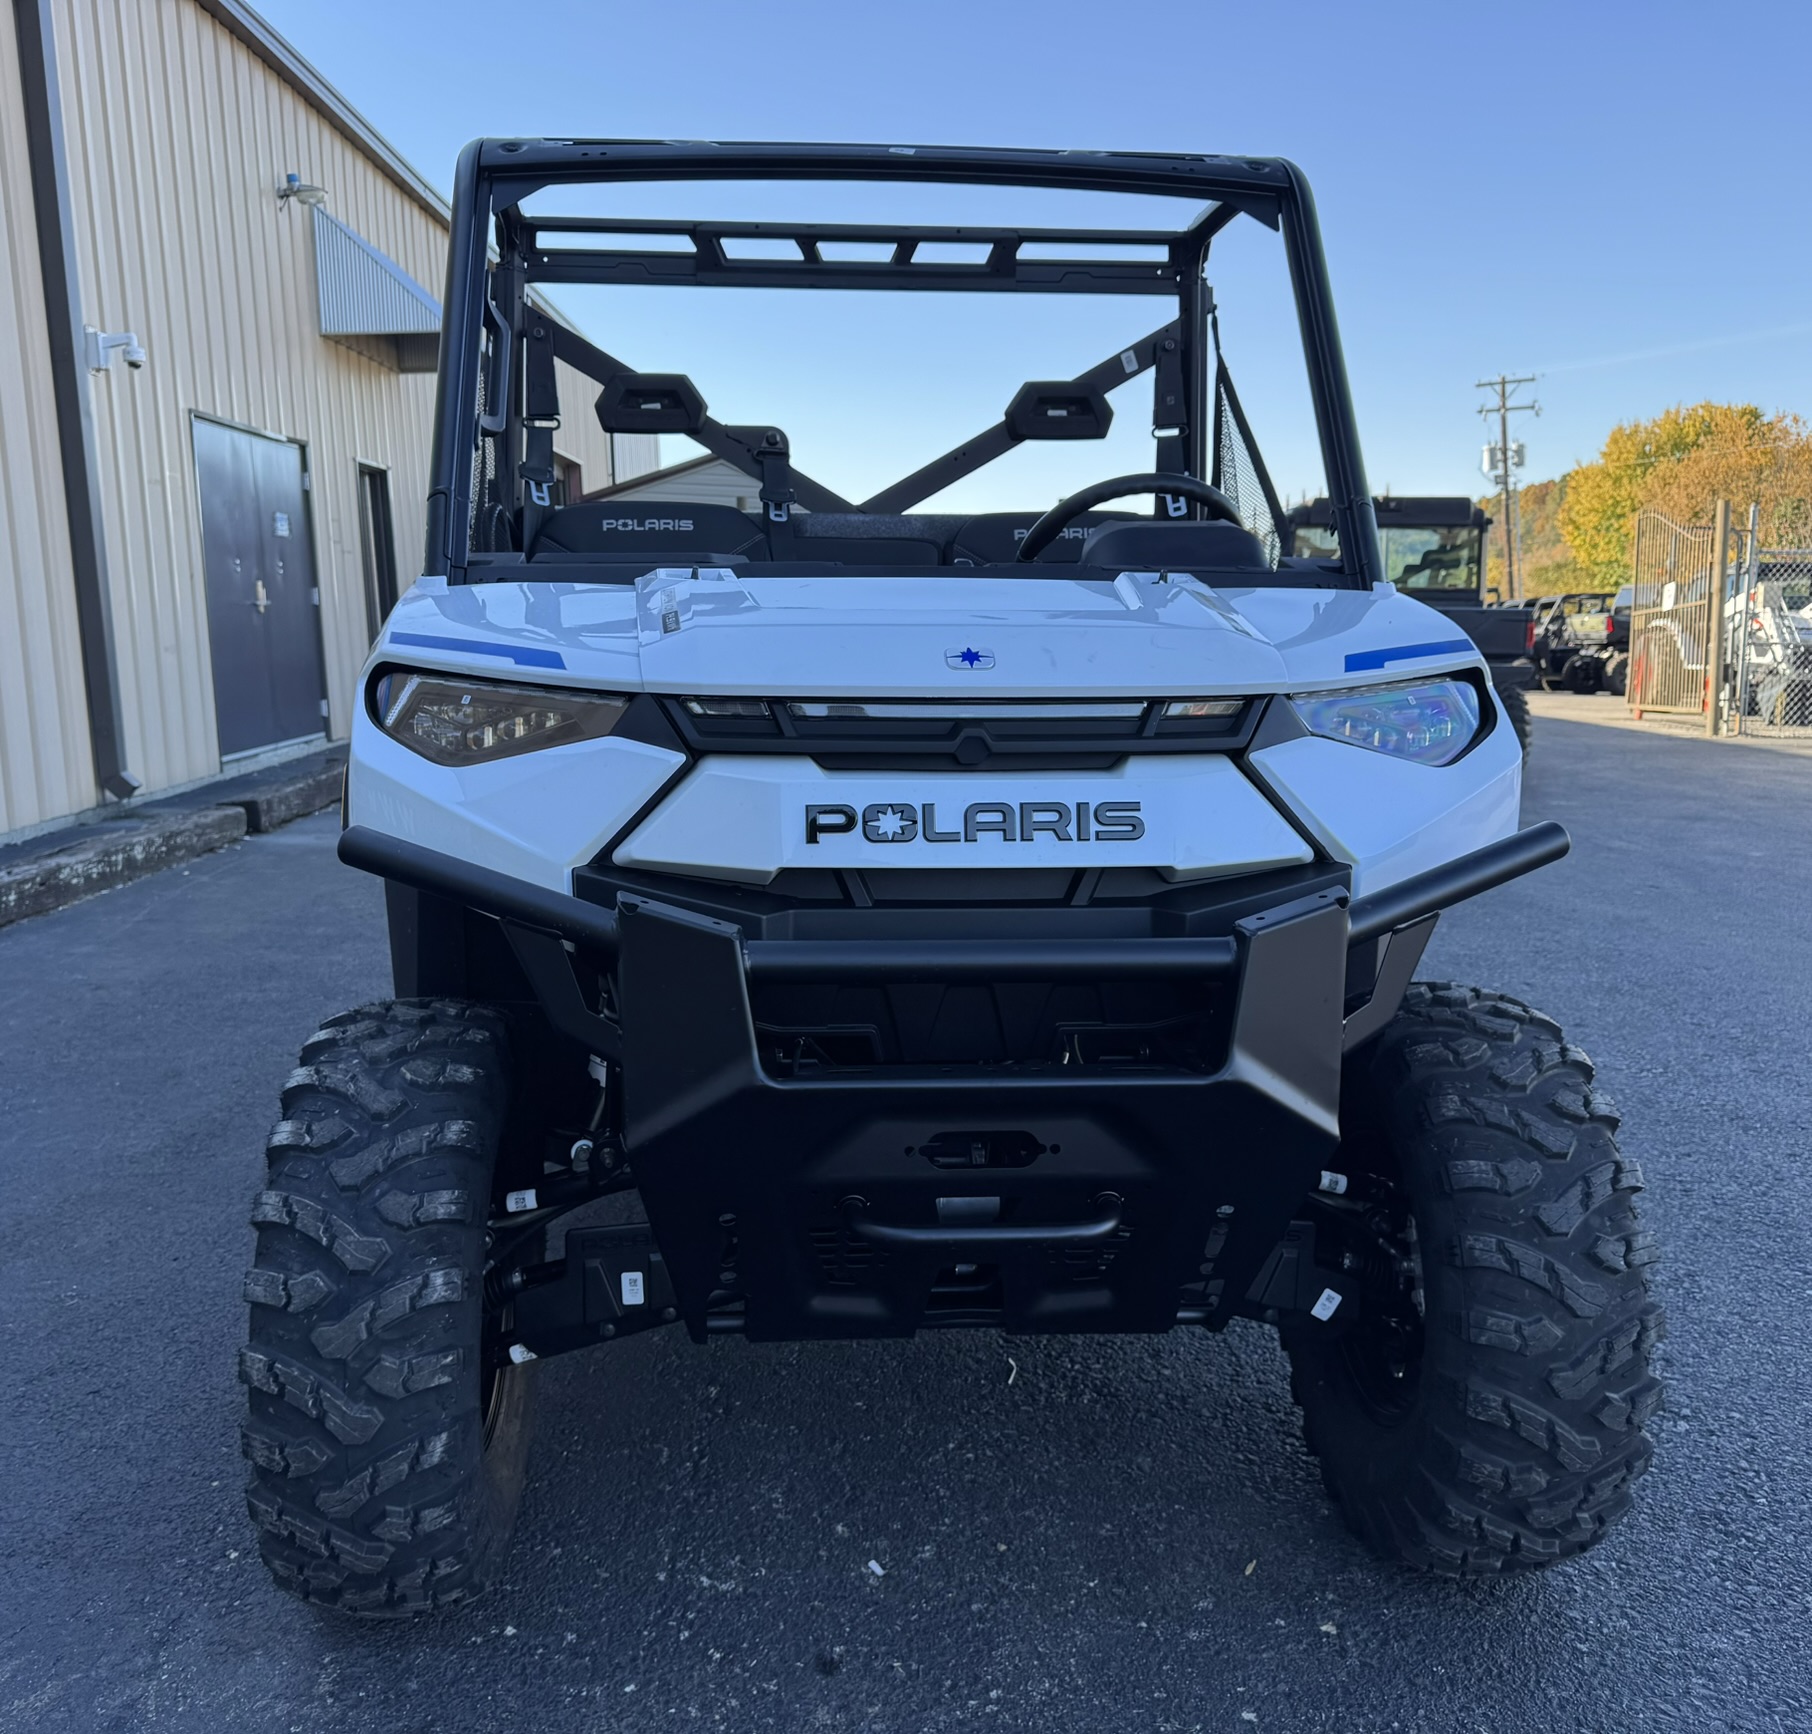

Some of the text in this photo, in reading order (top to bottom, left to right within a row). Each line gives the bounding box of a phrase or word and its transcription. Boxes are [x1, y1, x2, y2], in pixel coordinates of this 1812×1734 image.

[602, 518, 694, 532] POLARIS
[1013, 527, 1096, 541] PARI
[805, 801, 1146, 845] POLARIS
